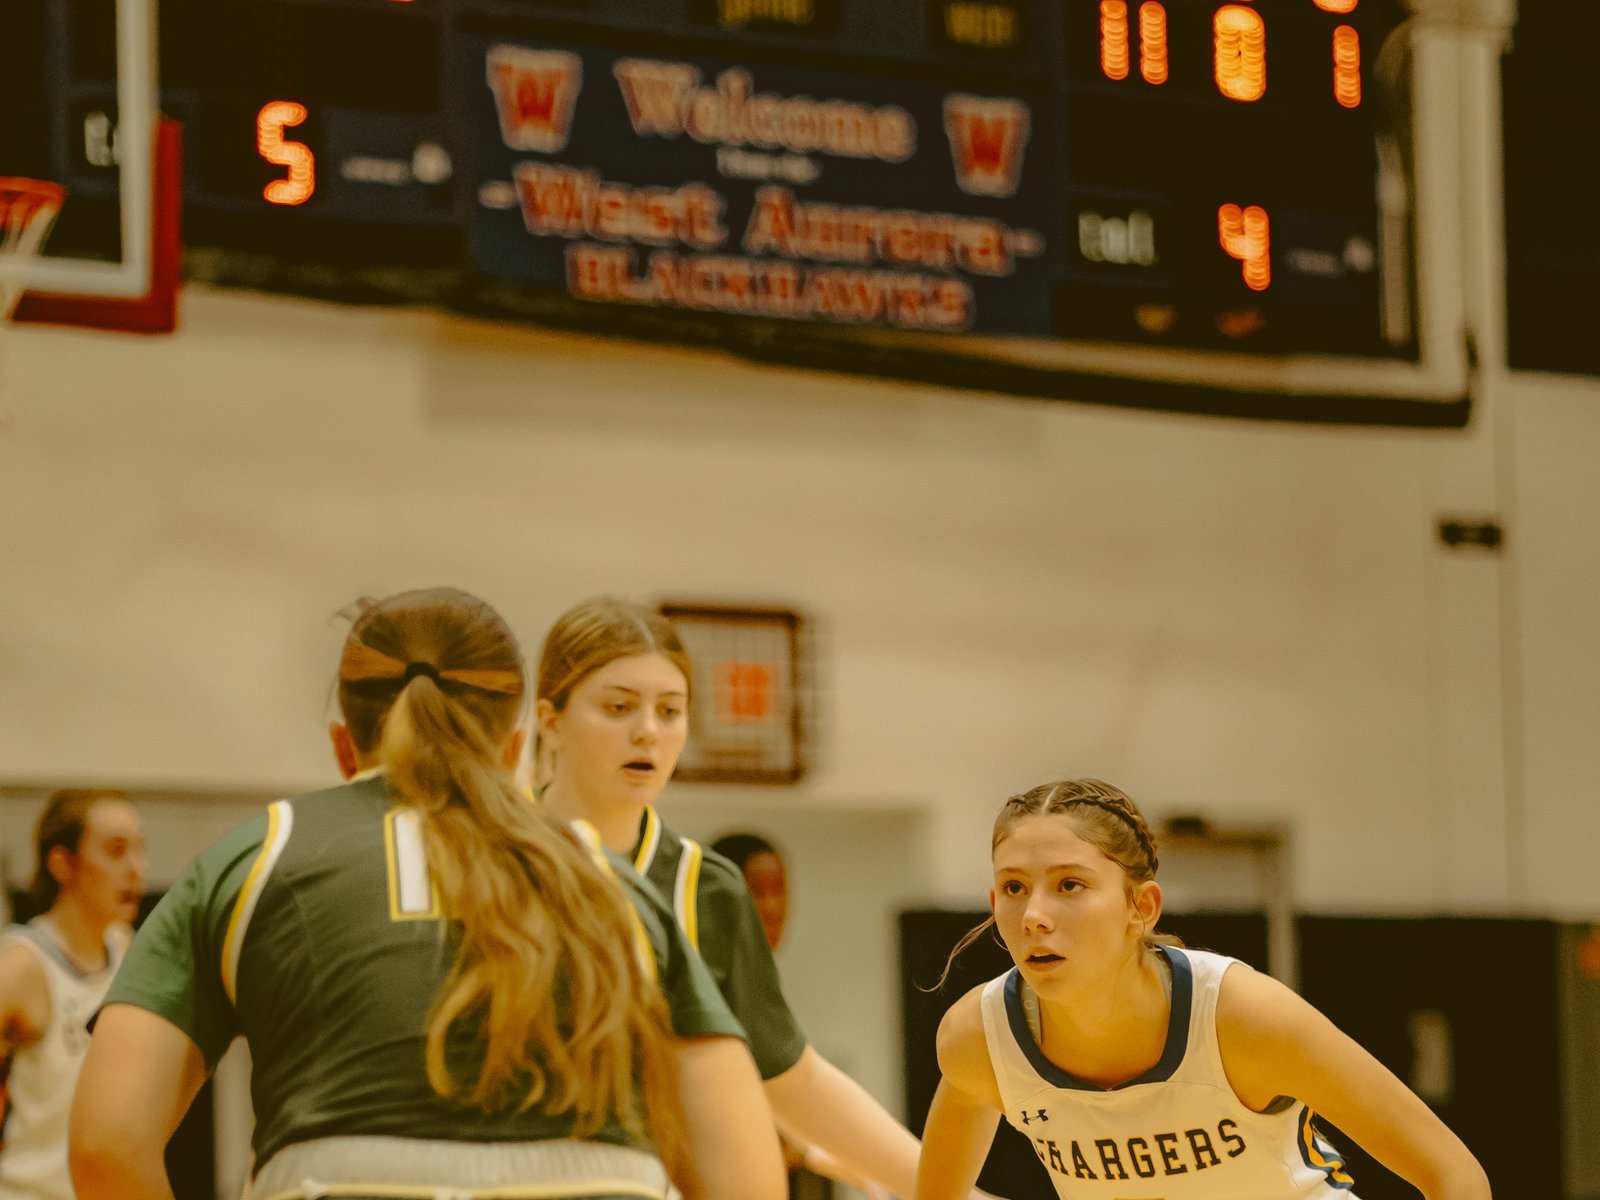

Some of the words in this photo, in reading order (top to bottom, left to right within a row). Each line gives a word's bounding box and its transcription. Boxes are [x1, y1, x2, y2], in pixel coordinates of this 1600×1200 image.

[257, 101, 314, 205] 5
[614, 57, 916, 162] Welcome
[566, 242, 972, 330] BLACKHAWKS
[1218, 203, 1271, 291] 4
